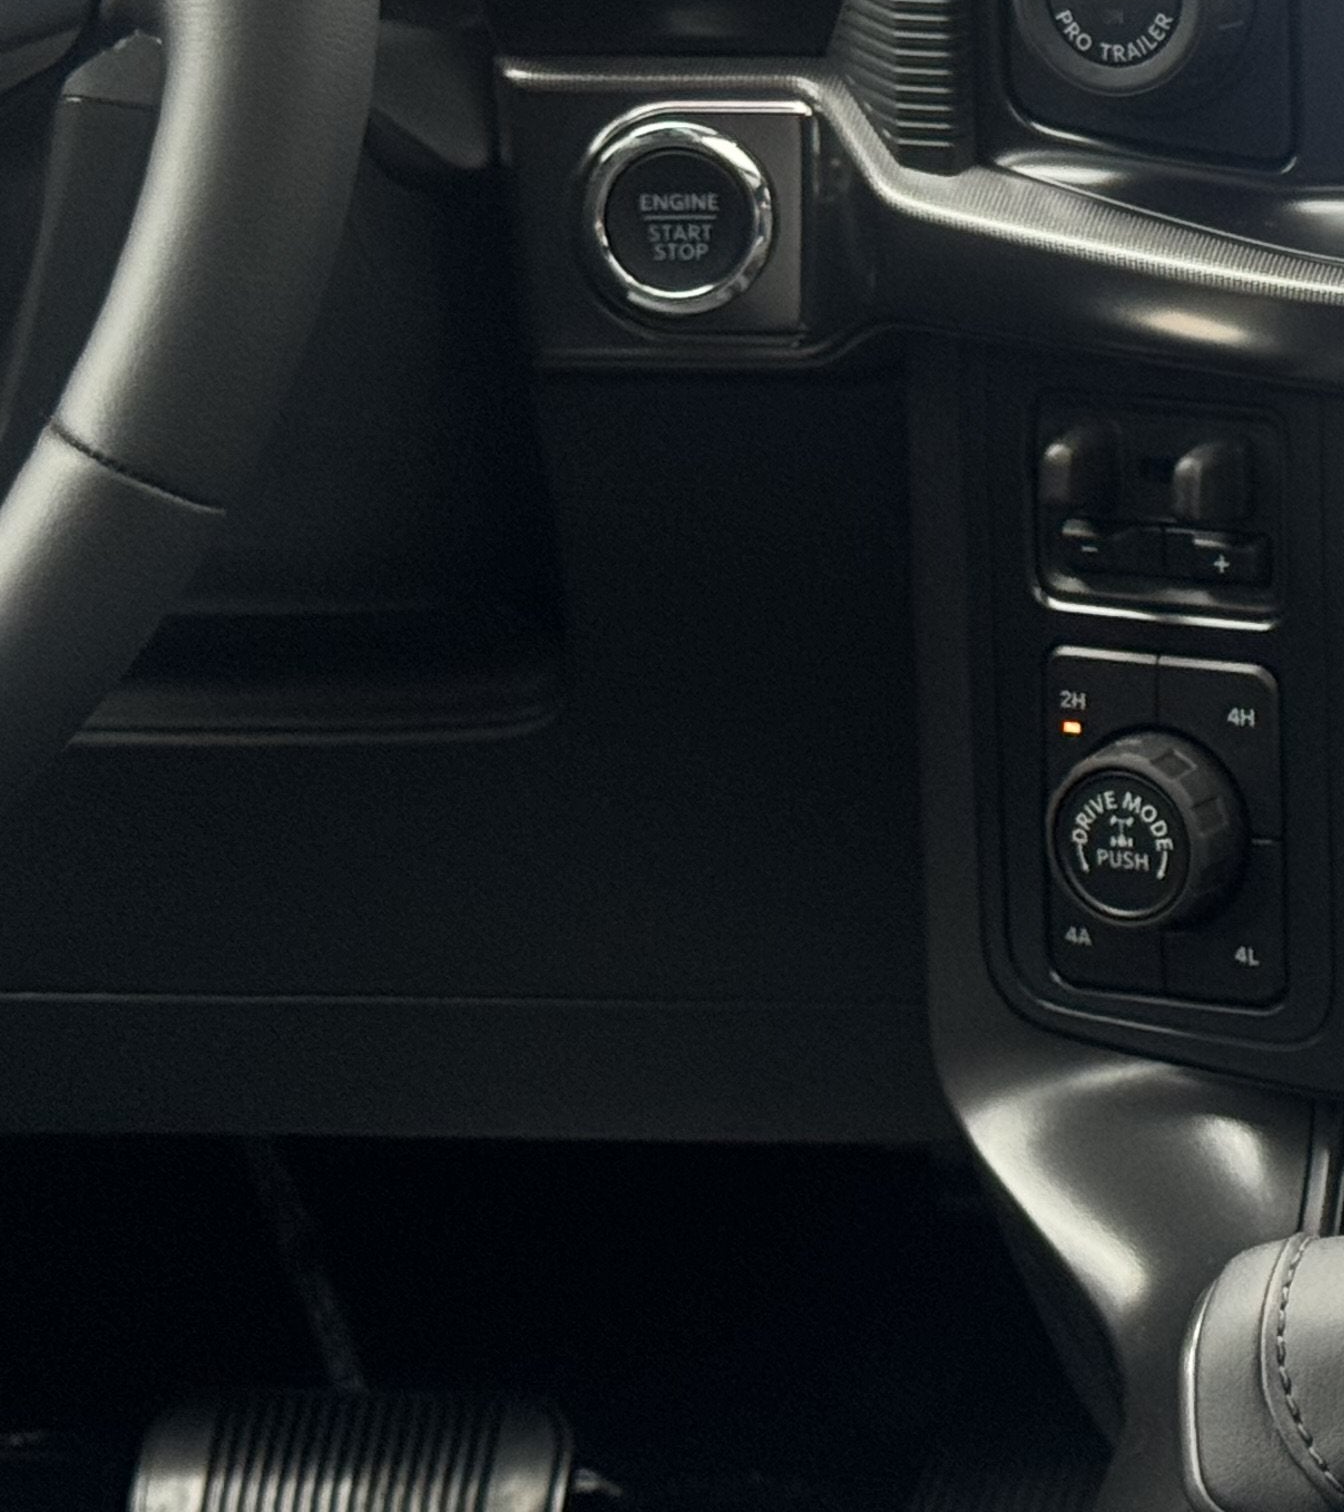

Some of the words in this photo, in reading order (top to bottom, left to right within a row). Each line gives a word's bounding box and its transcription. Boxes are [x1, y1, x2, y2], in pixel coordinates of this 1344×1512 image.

[1055, 9, 1093, 51] PRO
[1099, 12, 1174, 63] TRAILER
[639, 193, 720, 211] ENGINE
[649, 224, 713, 242] START
[653, 243, 709, 261] STOP
[1060, 690, 1086, 709] 2H
[1227, 707, 1255, 727] 4H
[1071, 790, 1118, 845] DRIVE
[1121, 791, 1174, 852] MODE
[1097, 848, 1150, 871] PUSH
[1065, 928, 1091, 945] 4A
[1234, 946, 1260, 966] 4L
